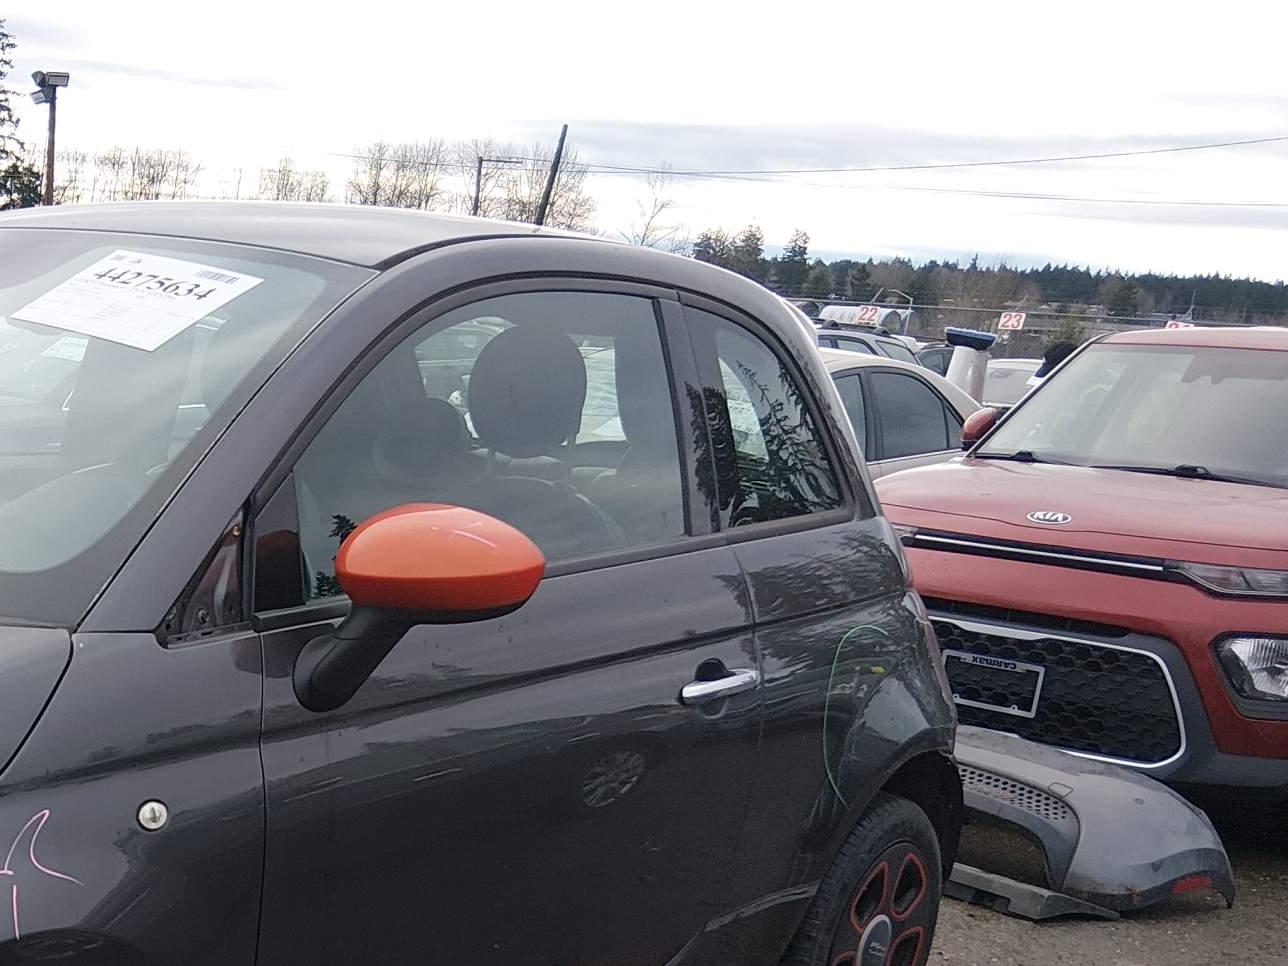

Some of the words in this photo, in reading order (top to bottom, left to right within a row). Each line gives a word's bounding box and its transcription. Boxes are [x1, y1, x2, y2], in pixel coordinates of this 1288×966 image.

[94, 267, 217, 300] 44275634
[858, 306, 878, 321] 22
[1001, 313, 1024, 329] 23
